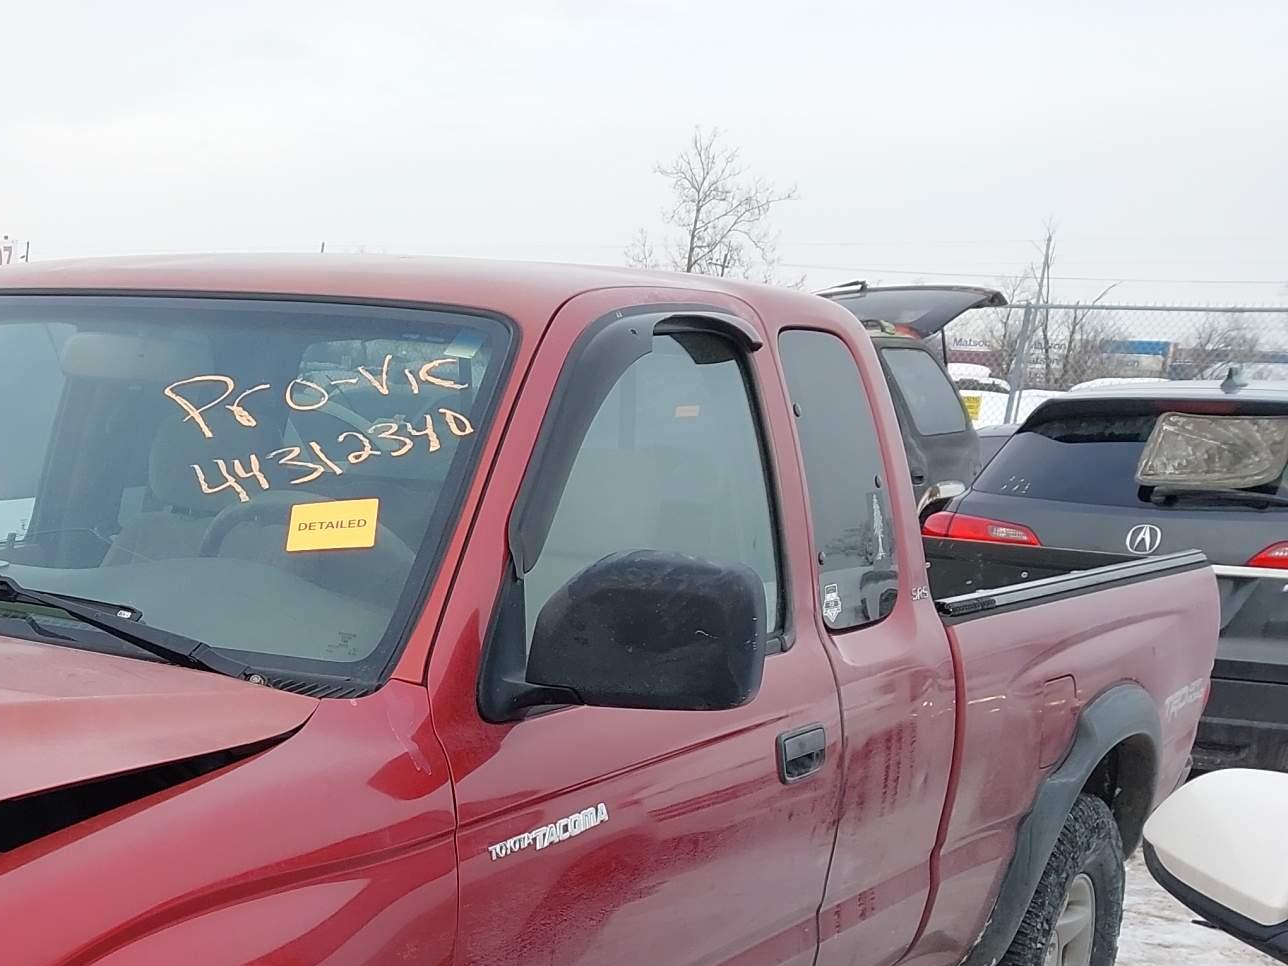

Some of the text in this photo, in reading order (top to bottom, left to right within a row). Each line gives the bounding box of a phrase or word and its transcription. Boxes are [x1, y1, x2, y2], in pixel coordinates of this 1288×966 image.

[189, 407, 475, 502] 44312340
[297, 517, 368, 532] DETAILED
[487, 802, 609, 861] TOYOTA TACOMA
